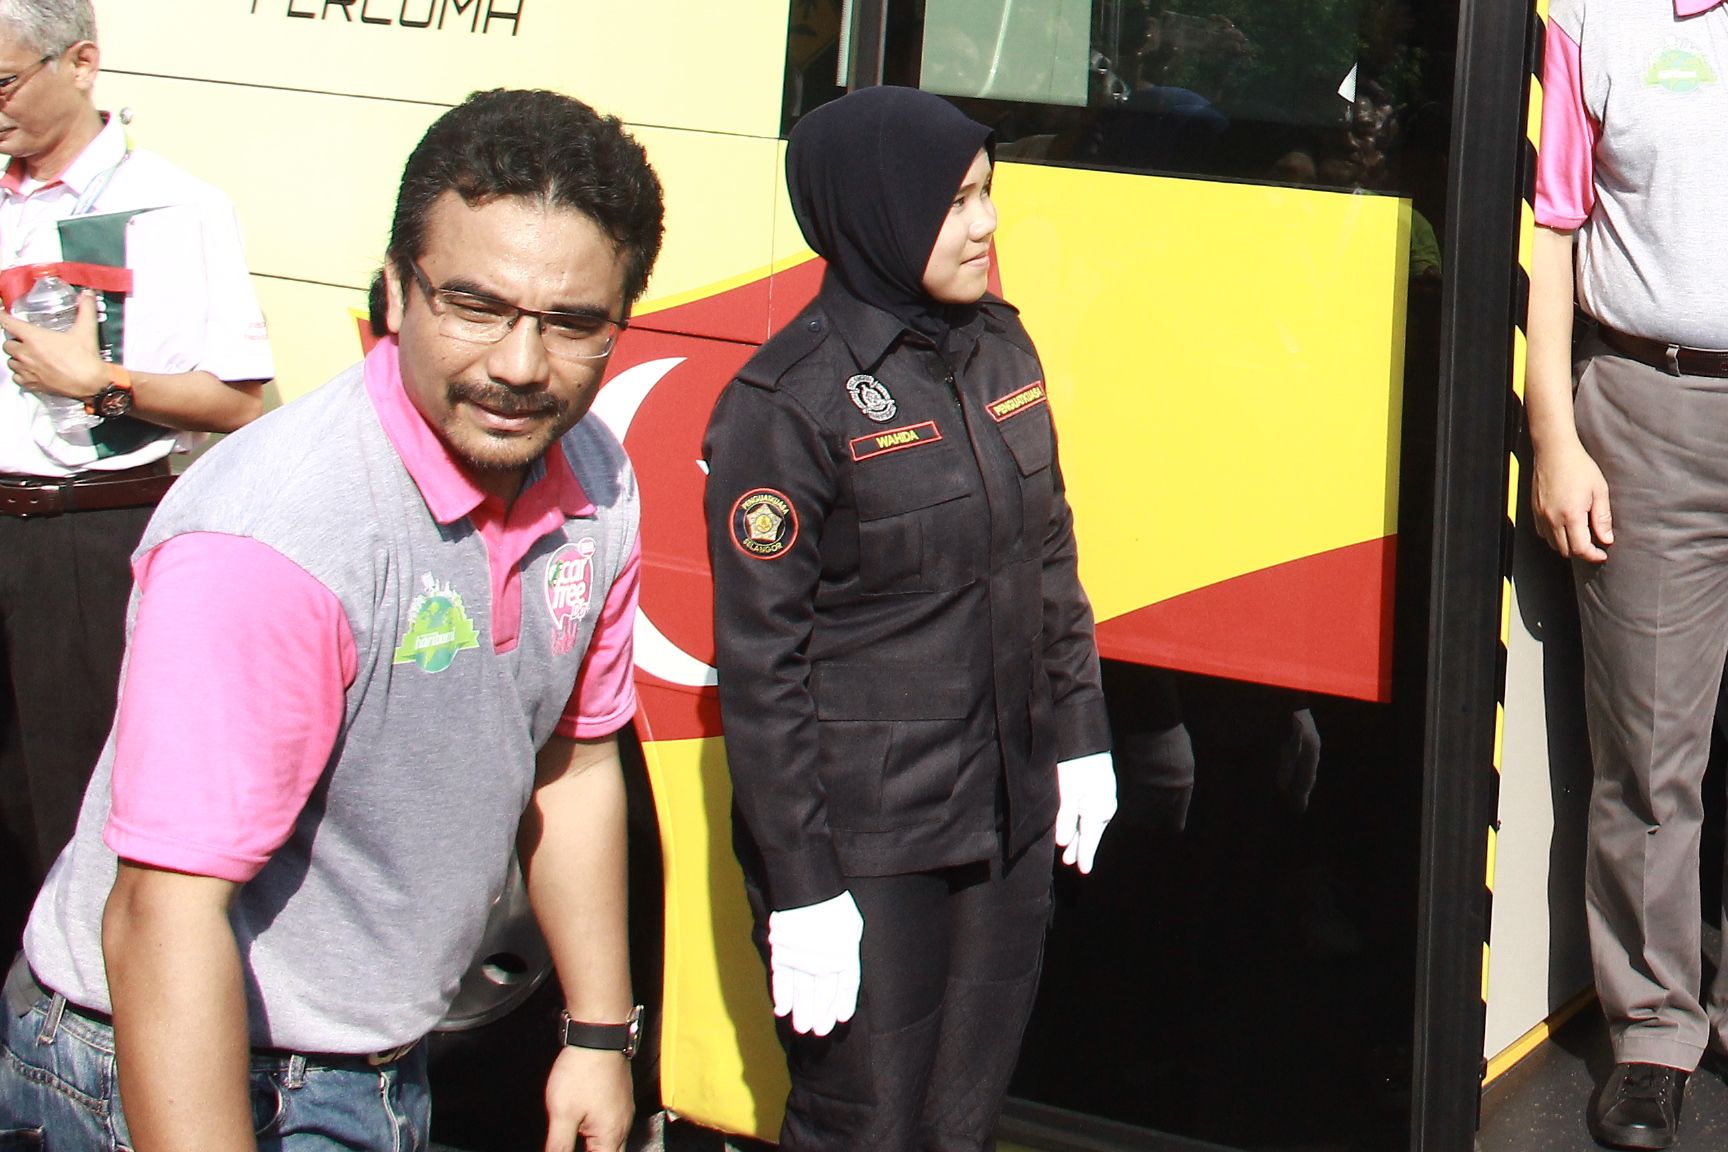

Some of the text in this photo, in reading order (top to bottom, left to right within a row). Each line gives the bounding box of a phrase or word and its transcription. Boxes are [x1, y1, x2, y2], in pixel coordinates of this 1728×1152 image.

[875, 430, 919, 448] WAHIDA
[743, 538, 784, 554] SELANGOR
[552, 581, 586, 609] free
